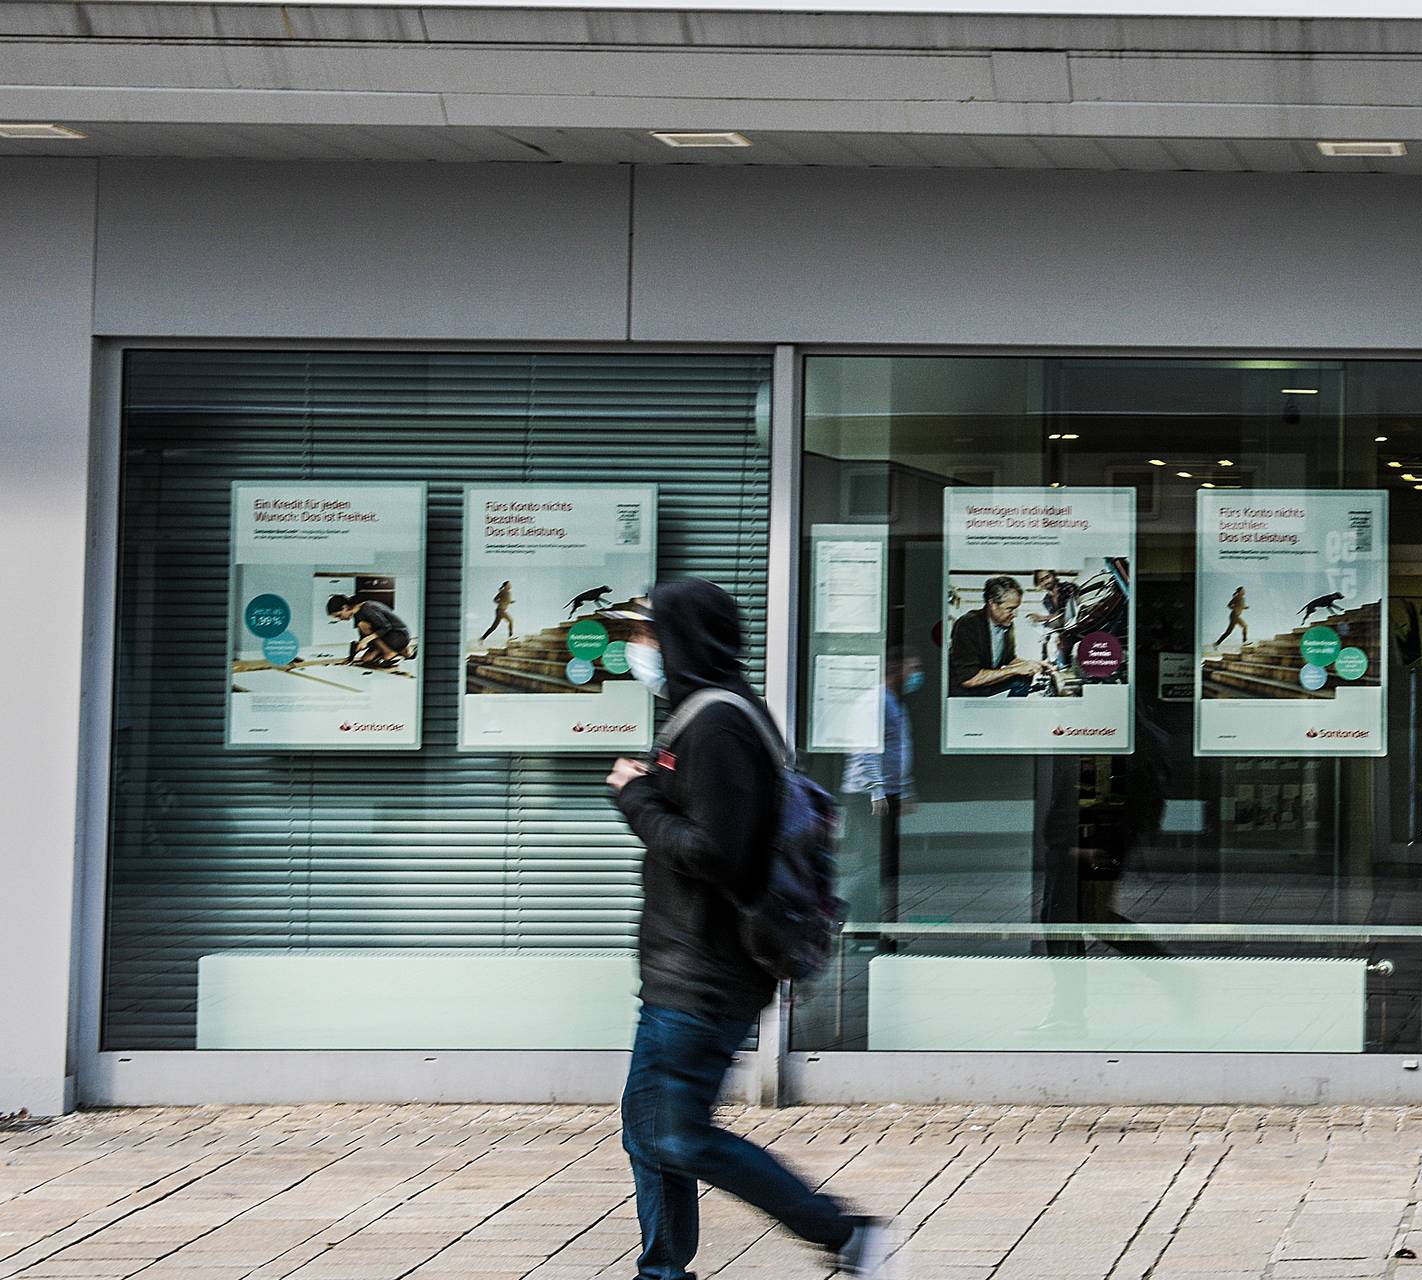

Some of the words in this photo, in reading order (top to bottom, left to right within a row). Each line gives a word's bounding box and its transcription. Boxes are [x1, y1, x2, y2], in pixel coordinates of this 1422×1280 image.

[255, 499, 270, 509] Ein
[272, 499, 302, 509] Kredit
[304, 499, 318, 509] für
[321, 499, 351, 512] jeden
[485, 501, 508, 512] Fürs
[511, 501, 540, 512] Konto
[541, 501, 573, 512] nichts
[302, 512, 320, 522] Das
[325, 512, 335, 522] ist
[1219, 507, 1241, 518] Fürs
[1243, 507, 1273, 518] Konto
[1275, 507, 1305, 518] nichts
[1006, 518, 1026, 528] Das
[1028, 518, 1040, 528] ist
[485, 526, 507, 537] Das
[508, 526, 519, 537] ist
[1219, 533, 1239, 543] Das
[1241, 533, 1253, 543] ist
[353, 722, 404, 732] Santander
[586, 723, 637, 733] Santander
[1065, 726, 1117, 736] Santander
[1319, 728, 1369, 739] Santander
